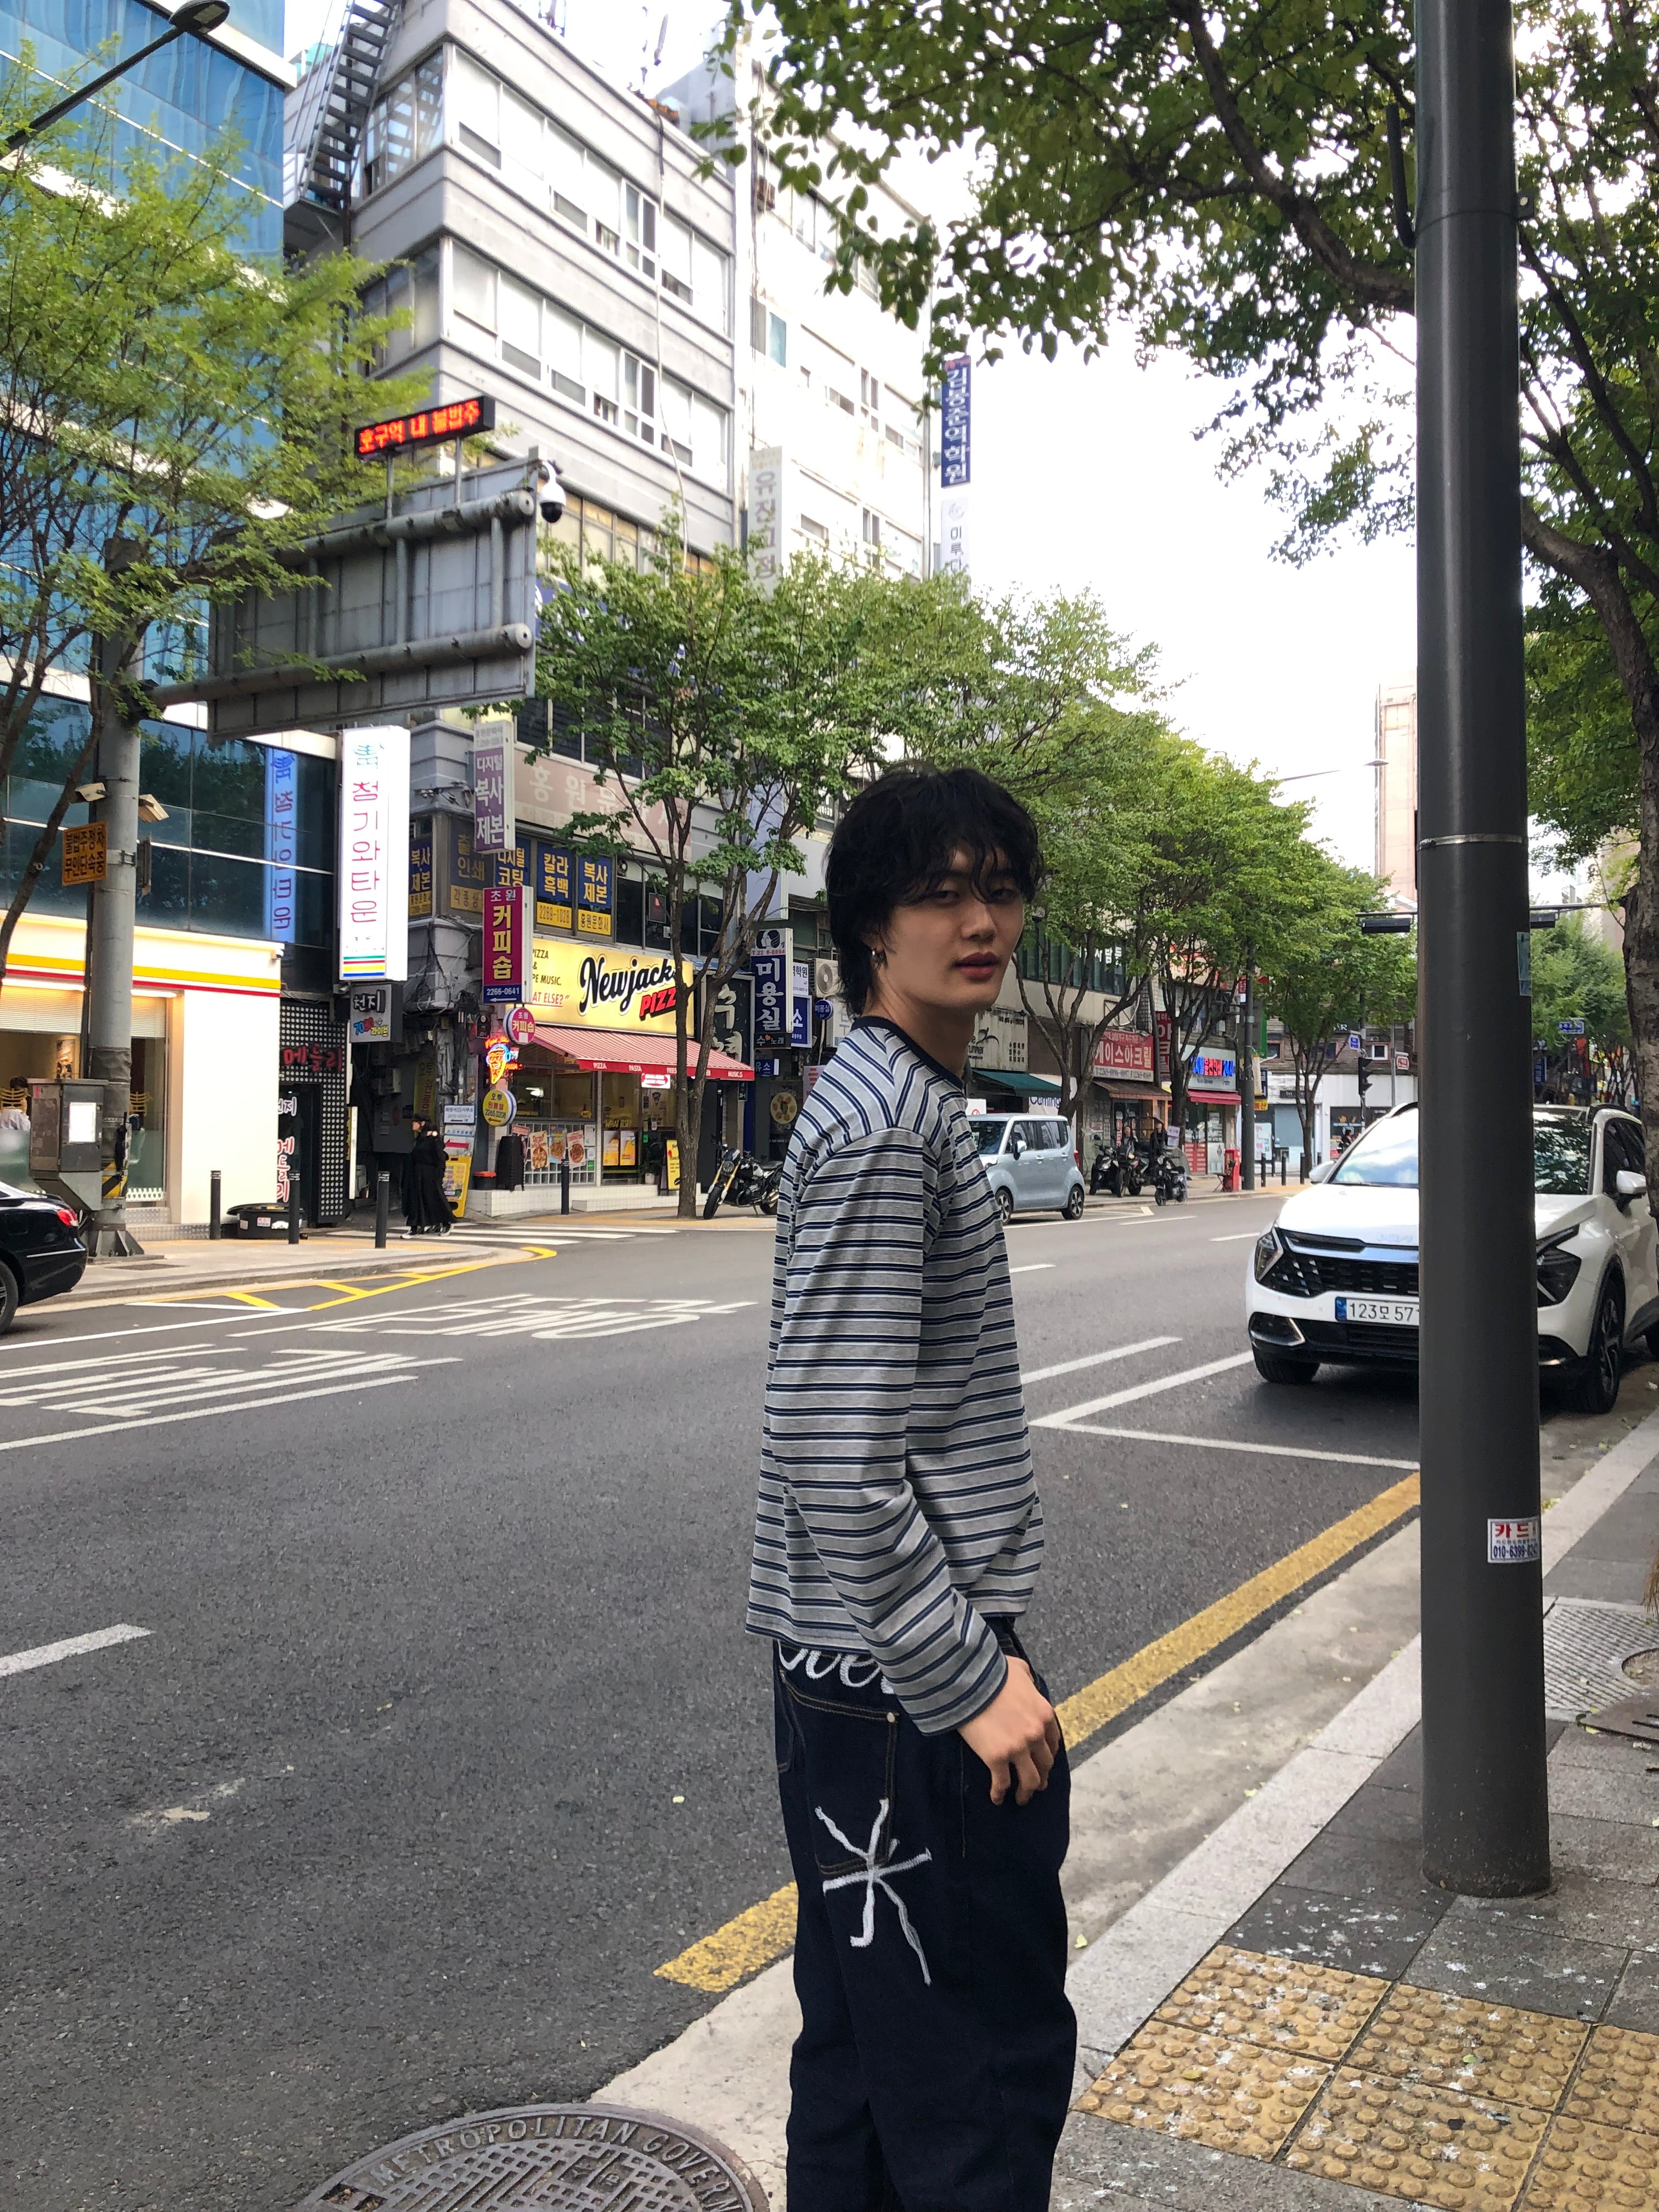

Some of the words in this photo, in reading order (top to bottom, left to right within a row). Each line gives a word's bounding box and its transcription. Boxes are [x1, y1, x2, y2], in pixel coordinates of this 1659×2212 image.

[410, 414, 428, 438] 내
[477, 754, 503, 773] 디지털
[476, 776, 504, 807] 복사
[476, 814, 504, 845] 제본
[411, 846, 431, 866] 복사
[544, 853, 569, 877] 칼라
[584, 861, 608, 885] 복사
[490, 889, 516, 901] 초원
[544, 876, 569, 899] 흑백
[583, 882, 608, 904] 제본
[492, 904, 512, 980] 커피숍
[579, 957, 675, 1013] Newjack
[755, 958, 785, 1031] 미용실
[354, 990, 380, 1012] 천지
[639, 986, 676, 1019] PIZZ
[512, 1020, 534, 1033] 커피숍
[283, 1043, 343, 1071] 메들리
[1350, 1302, 1389, 1320] 123모
[1395, 1306, 1420, 1322] 57
[1495, 1522, 1536, 1538] 카드
[369, 2116, 639, 2186] METROPOLITAN
